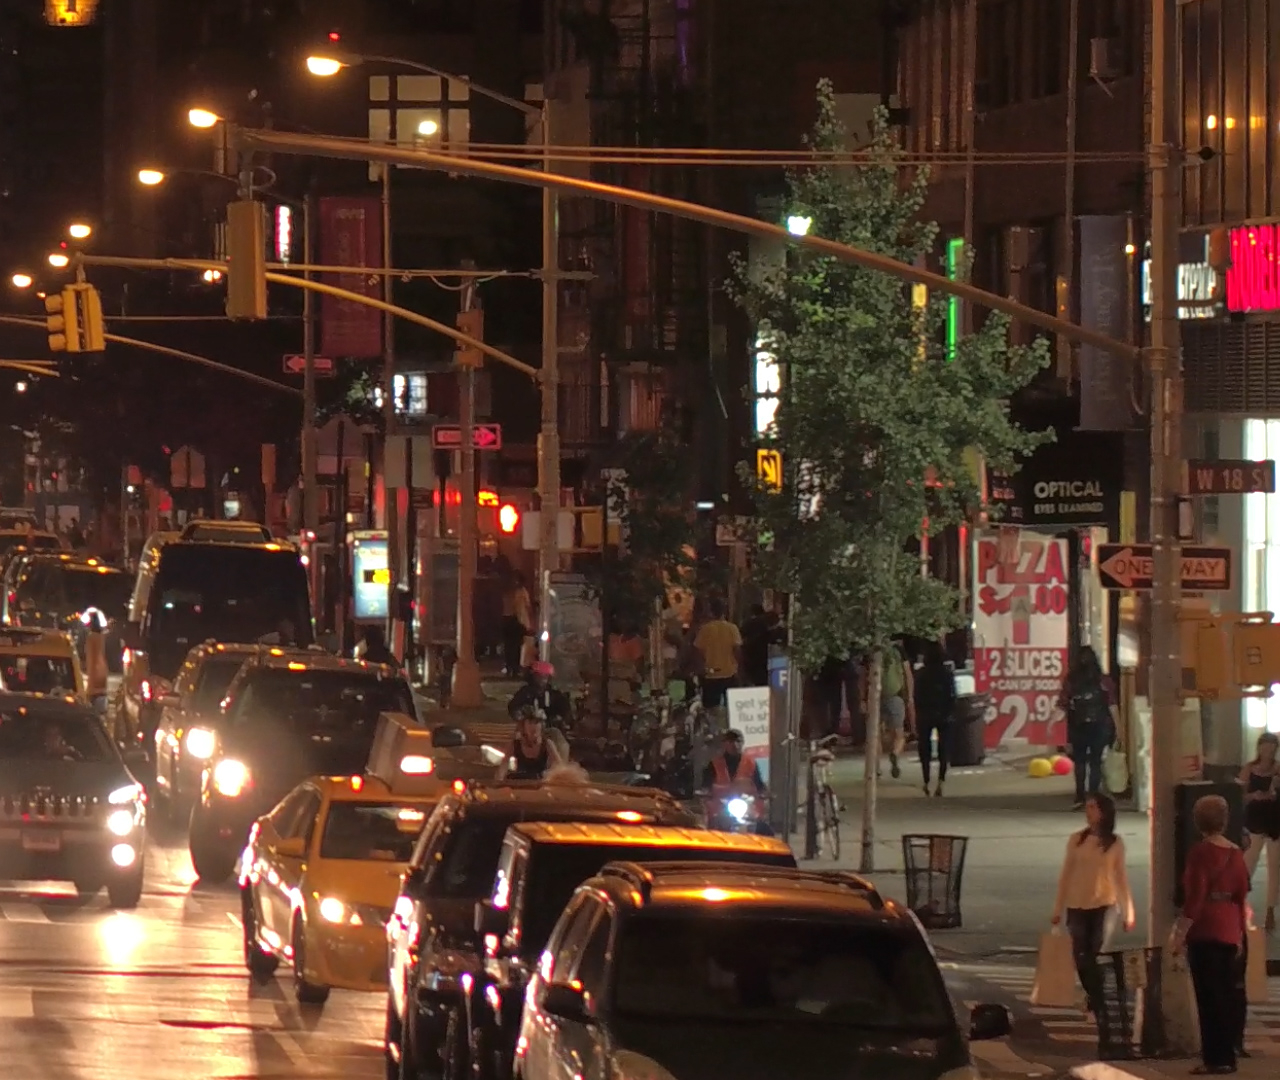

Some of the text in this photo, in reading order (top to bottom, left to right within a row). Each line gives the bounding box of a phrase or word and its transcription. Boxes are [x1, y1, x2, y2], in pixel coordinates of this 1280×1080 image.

[1197, 468, 1214, 490] W
[1222, 468, 1243, 490] 18
[1033, 480, 1104, 499] OPTICAL
[1113, 559, 1154, 576] ONE
[989, 650, 1002, 677] 2
[1003, 650, 1063, 677] SLICES
